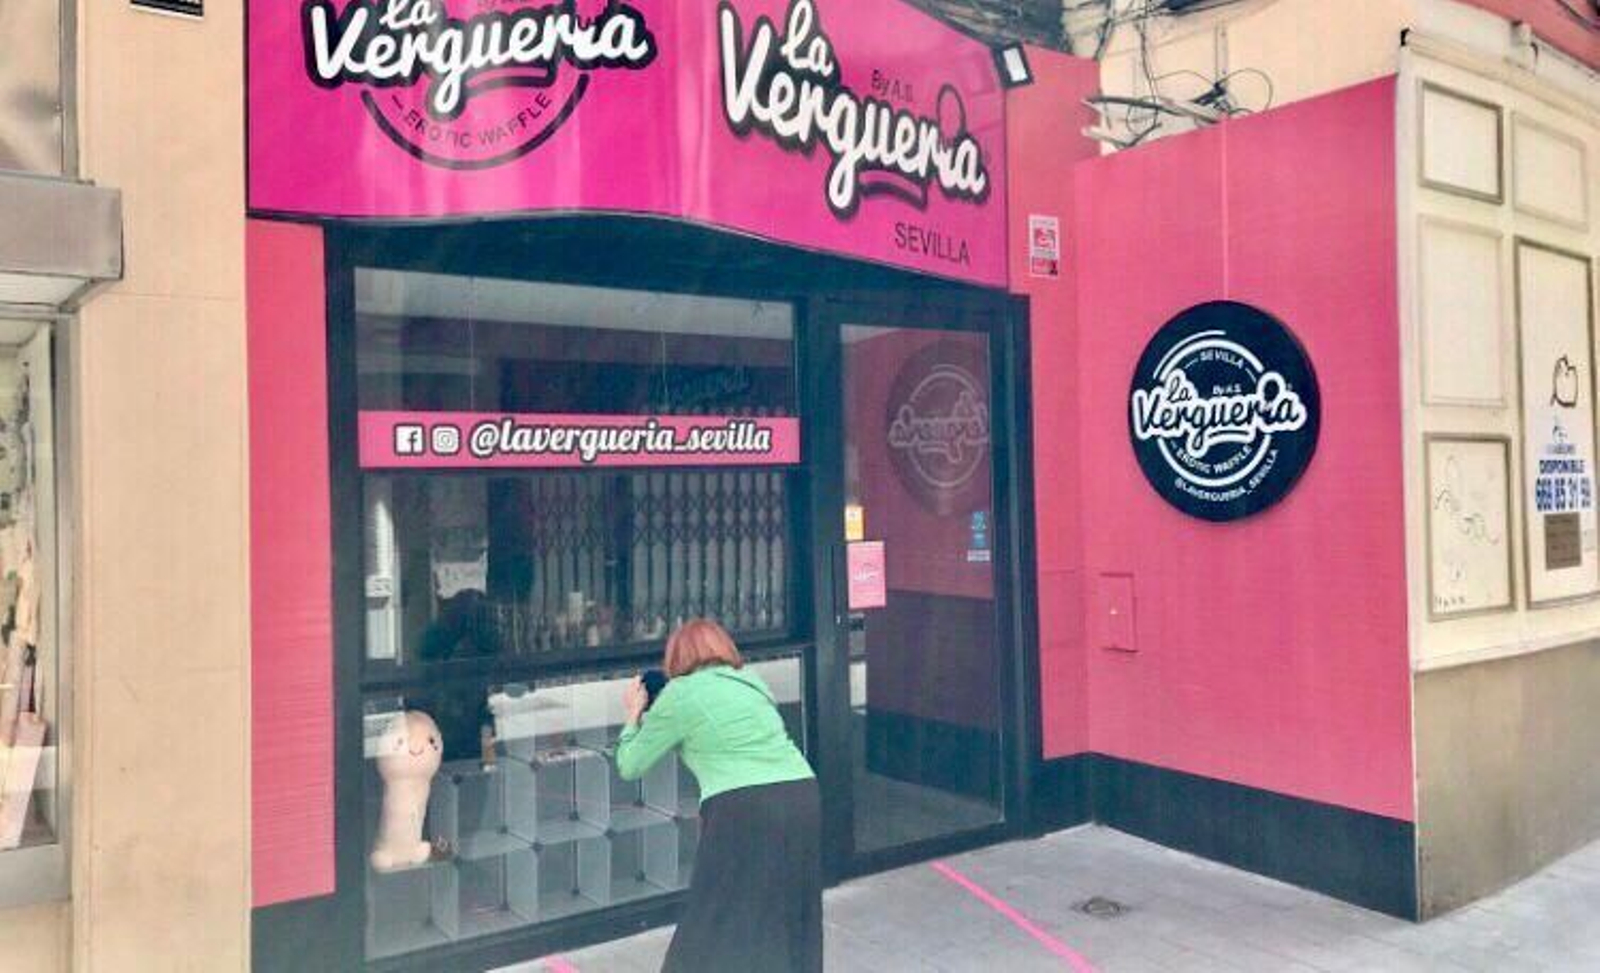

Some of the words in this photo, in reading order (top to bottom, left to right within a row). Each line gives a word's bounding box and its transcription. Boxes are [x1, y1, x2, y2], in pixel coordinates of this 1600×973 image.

[780, 0, 834, 77] la
[404, 108, 472, 148] EROTIC
[478, 91, 553, 146] WAFFLE
[894, 221, 971, 266] SEVILLA
[1200, 348, 1244, 370] SEVILLA
[470, 418, 772, 462] @lavergueria_sevilla
[1176, 447, 1211, 474] EROTIC
[1539, 459, 1586, 474] DISPONIBLE
